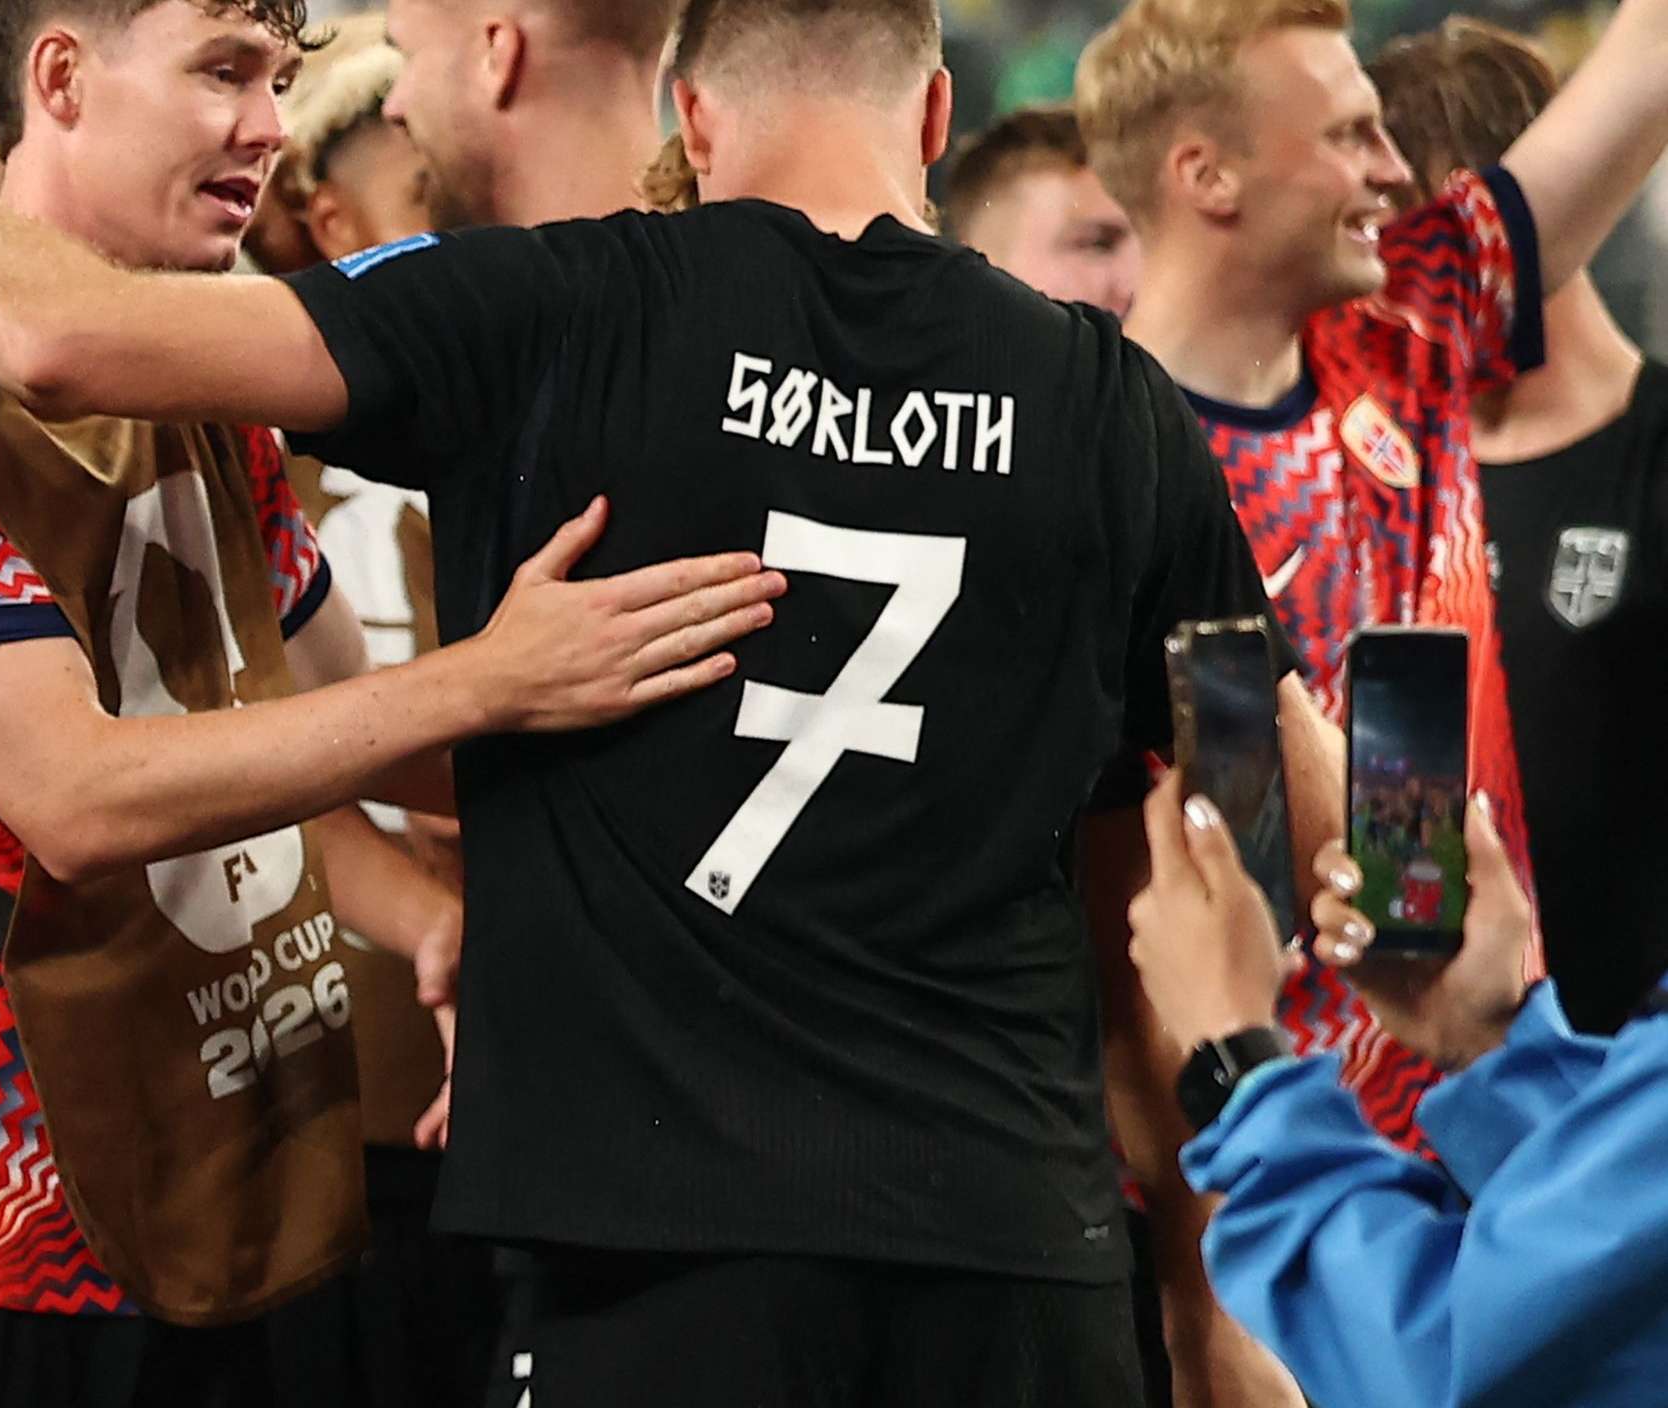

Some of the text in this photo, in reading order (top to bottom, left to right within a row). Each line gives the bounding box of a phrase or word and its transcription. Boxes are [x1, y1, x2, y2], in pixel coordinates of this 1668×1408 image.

[721, 351, 1017, 475] SØRLOTH
[684, 510, 967, 916] 7
[273, 909, 335, 972] CUP
